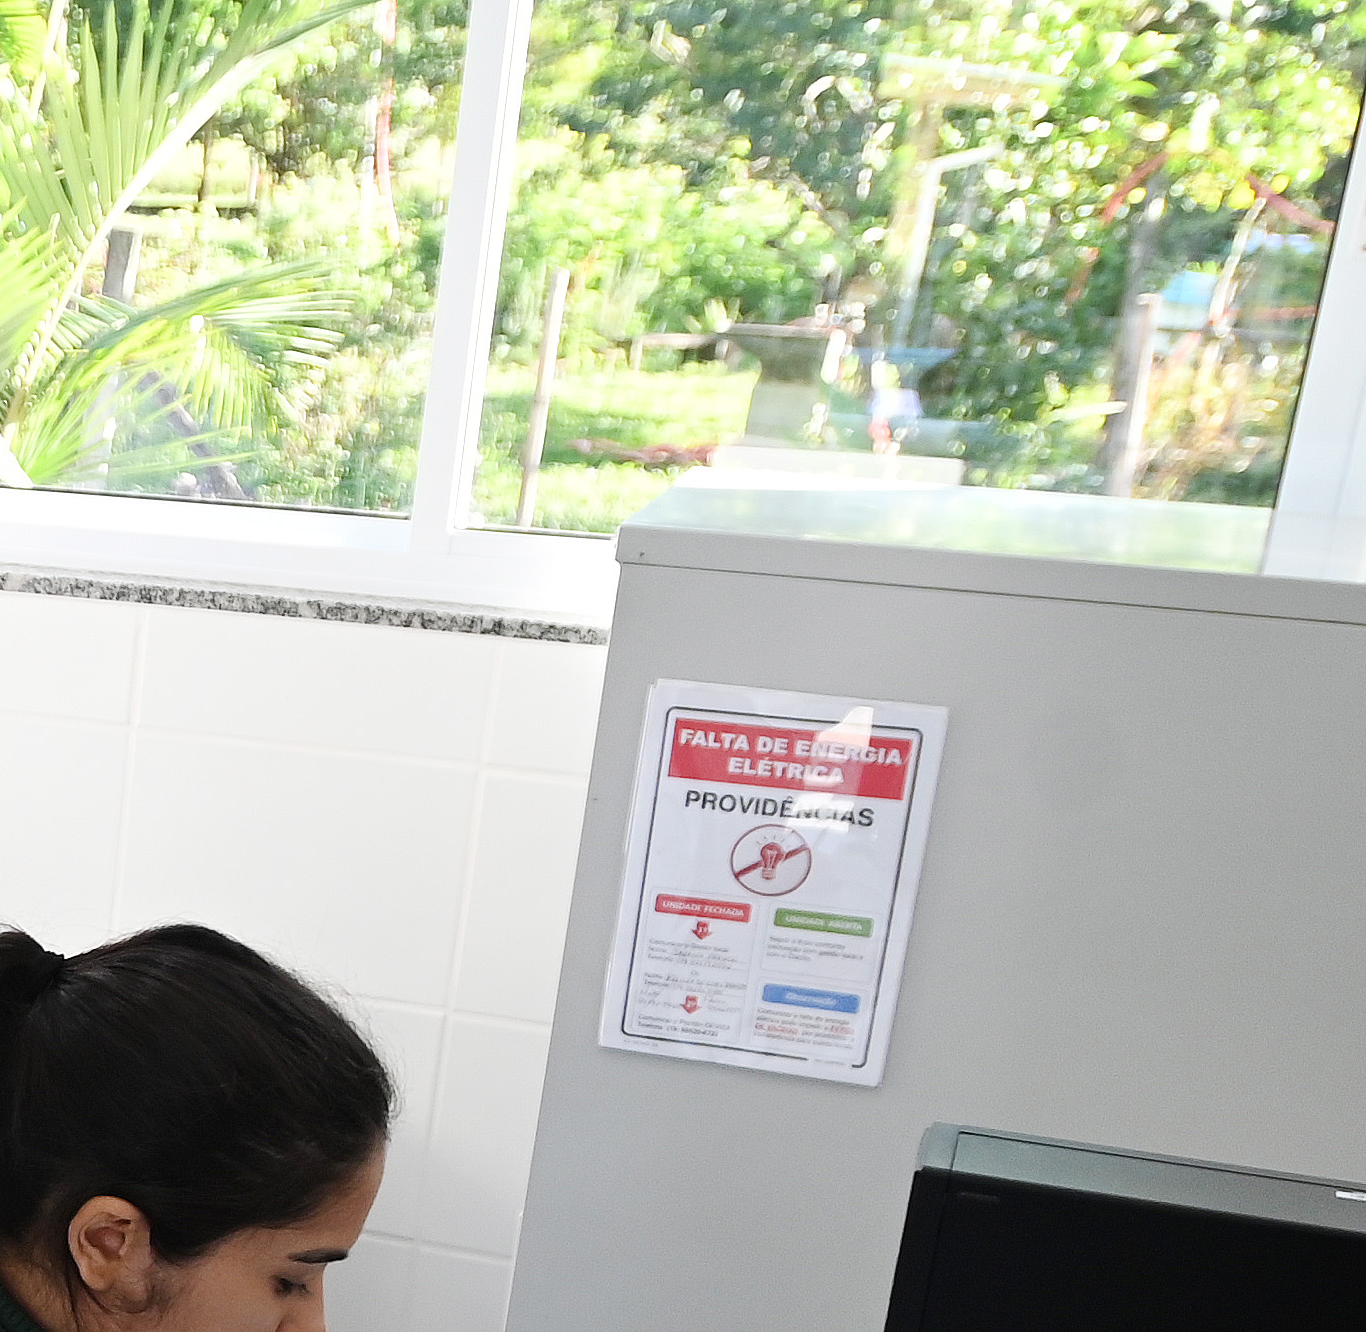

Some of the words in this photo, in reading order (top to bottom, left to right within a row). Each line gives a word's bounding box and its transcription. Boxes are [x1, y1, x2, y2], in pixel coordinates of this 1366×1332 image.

[679, 728, 750, 751] FALTA
[756, 736, 789, 755] DE
[795, 739, 904, 766] ENERGIA
[728, 757, 844, 784] ELÉTRICA
